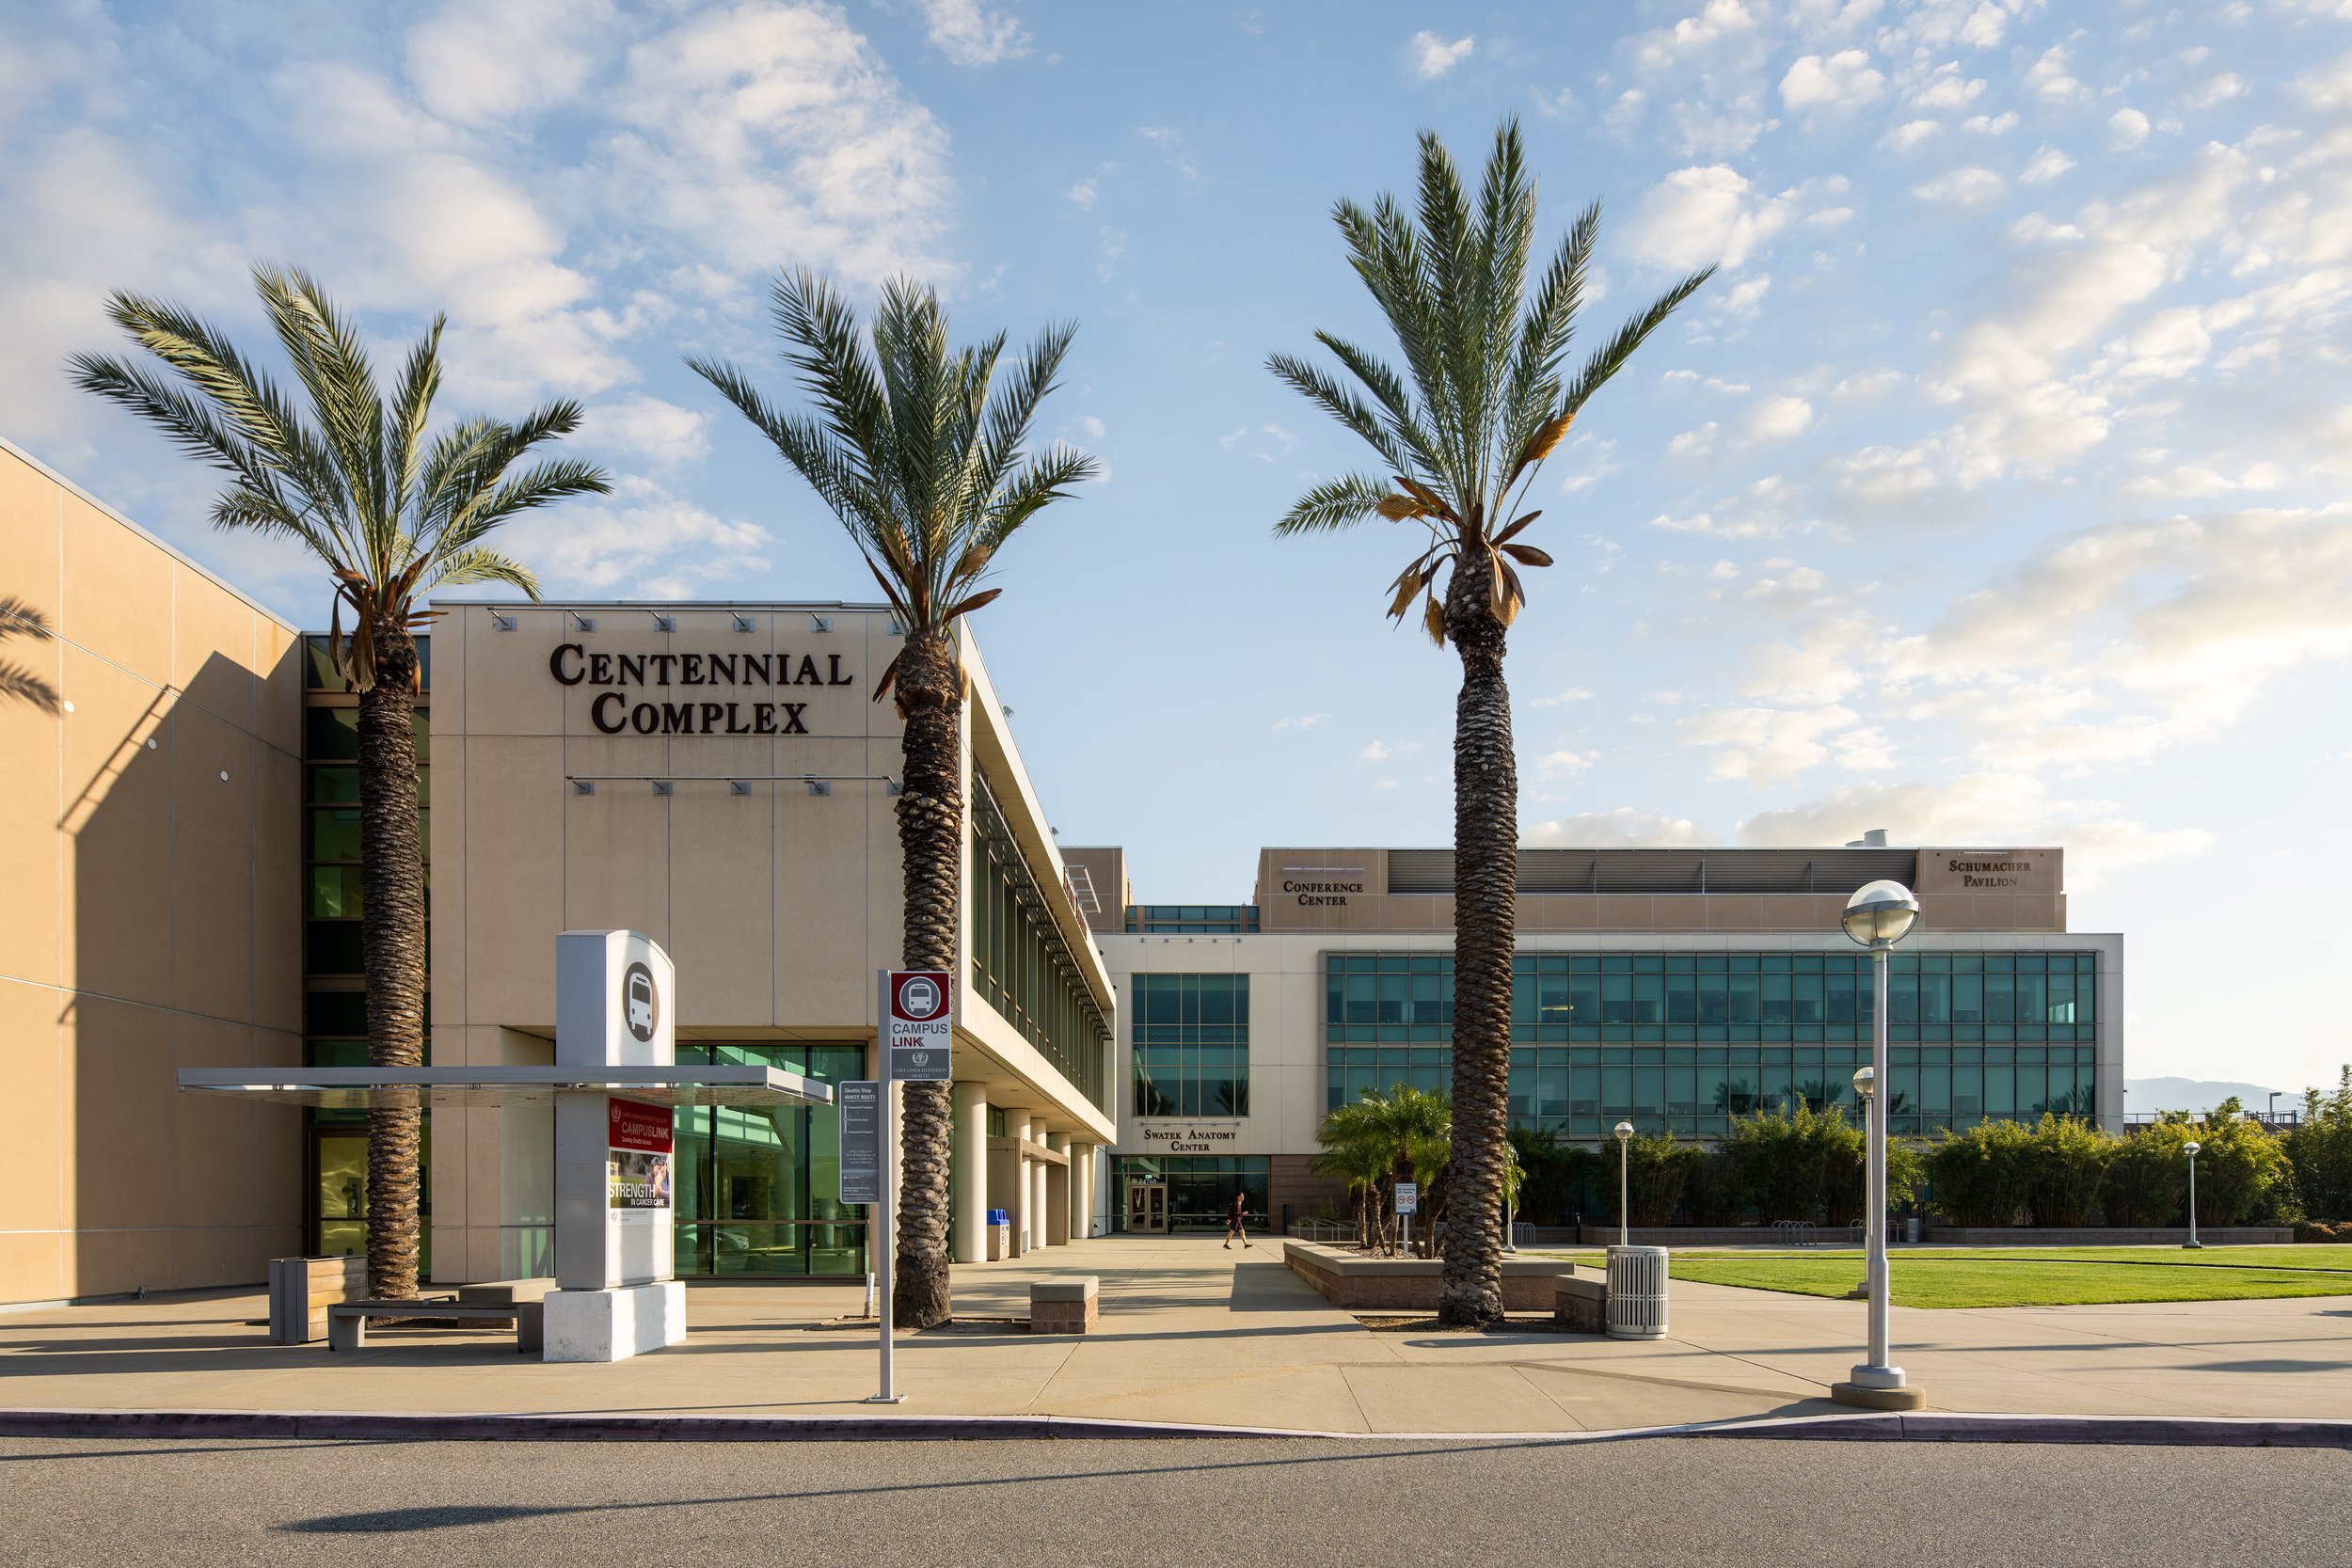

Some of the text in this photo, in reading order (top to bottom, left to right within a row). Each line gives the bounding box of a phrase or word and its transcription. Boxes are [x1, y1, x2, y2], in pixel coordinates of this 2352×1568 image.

[549, 643, 853, 686] CENTENNIAL
[591, 692, 809, 735] COMPLEX
[1949, 860, 2031, 872] SCHUMACHER
[1283, 880, 1363, 893] CONFERENCE
[1963, 876, 2017, 887] PAVILION
[1297, 894, 1347, 906] CENTER
[892, 1023, 948, 1035] CAMPUS
[892, 1037, 925, 1047] LINK
[1144, 1129, 1237, 1140] SWATEK ANATOMY
[1170, 1141, 1210, 1151] CENTER
[610, 1182, 656, 1198] STRENGTH
